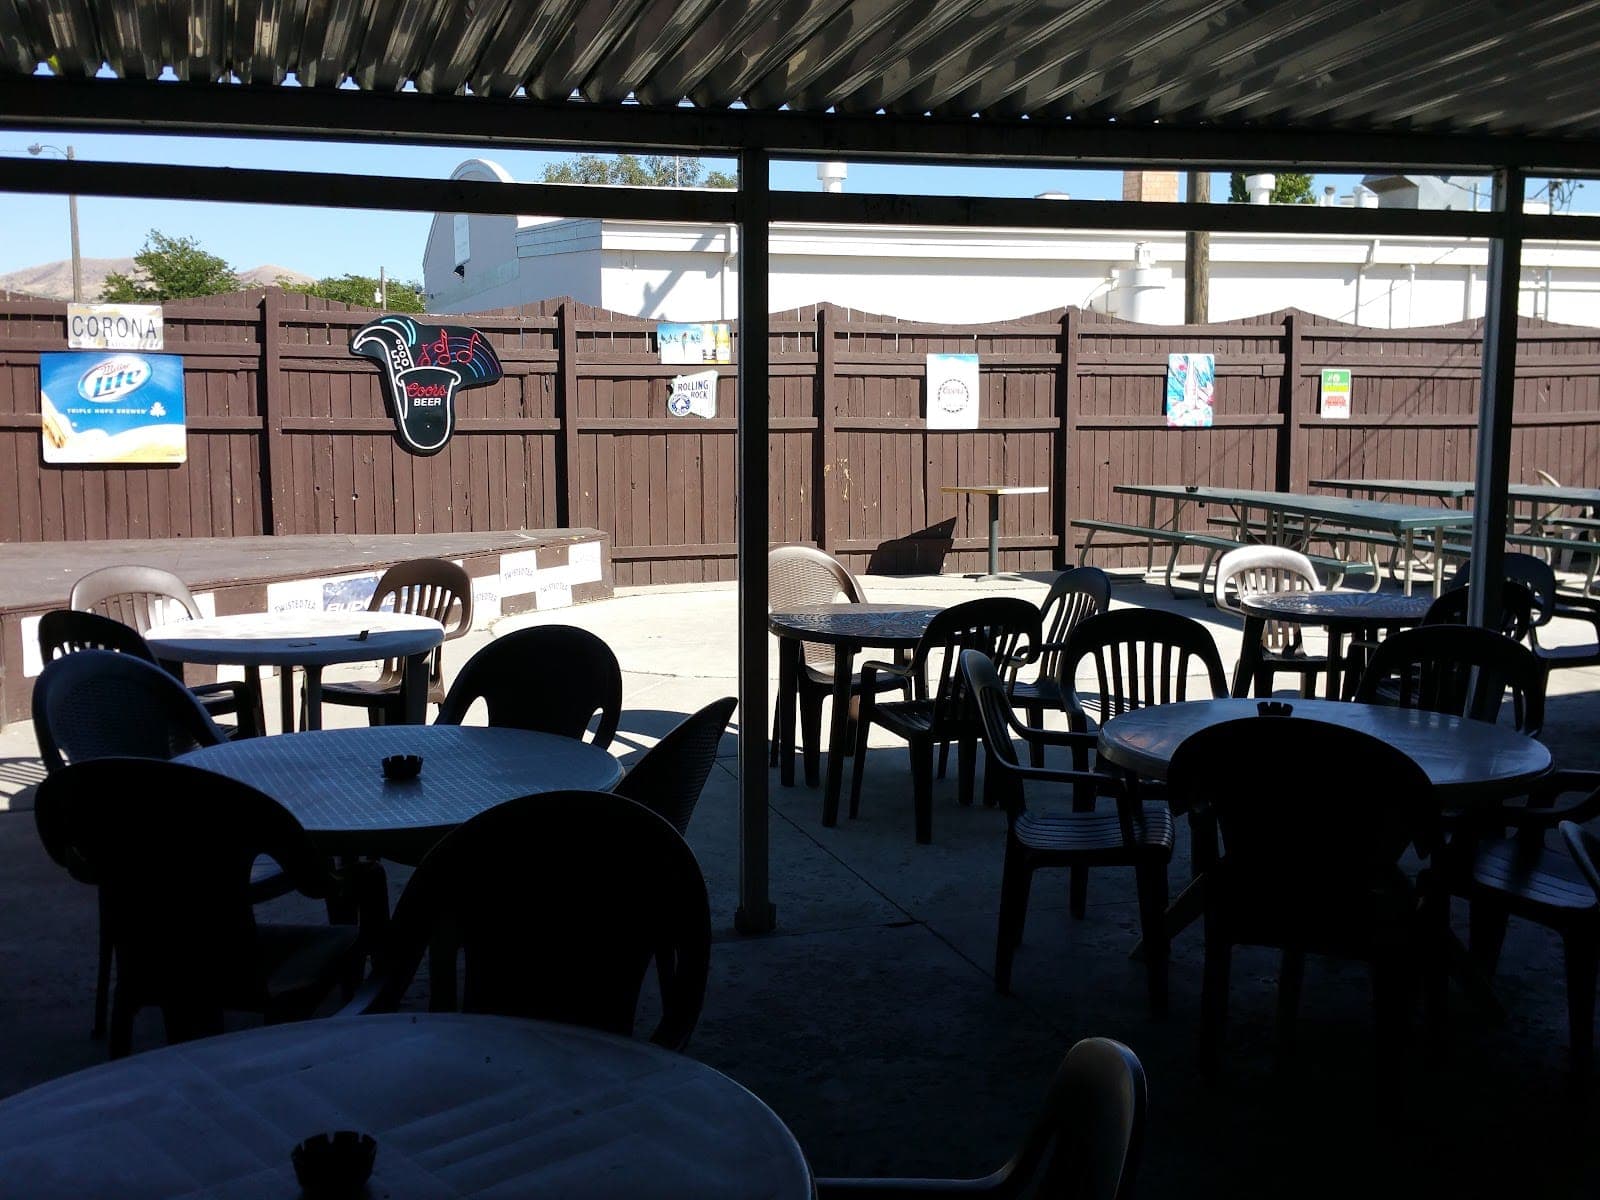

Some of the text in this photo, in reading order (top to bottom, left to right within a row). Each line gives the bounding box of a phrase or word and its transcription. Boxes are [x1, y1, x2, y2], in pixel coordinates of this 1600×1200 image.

[72, 315, 157, 339] CORONA
[92, 369, 141, 398] Lite
[407, 382, 448, 397] Coors
[677, 380, 708, 392] ROLLING
[413, 397, 441, 406] BEER
[690, 391, 708, 399] ROCK
